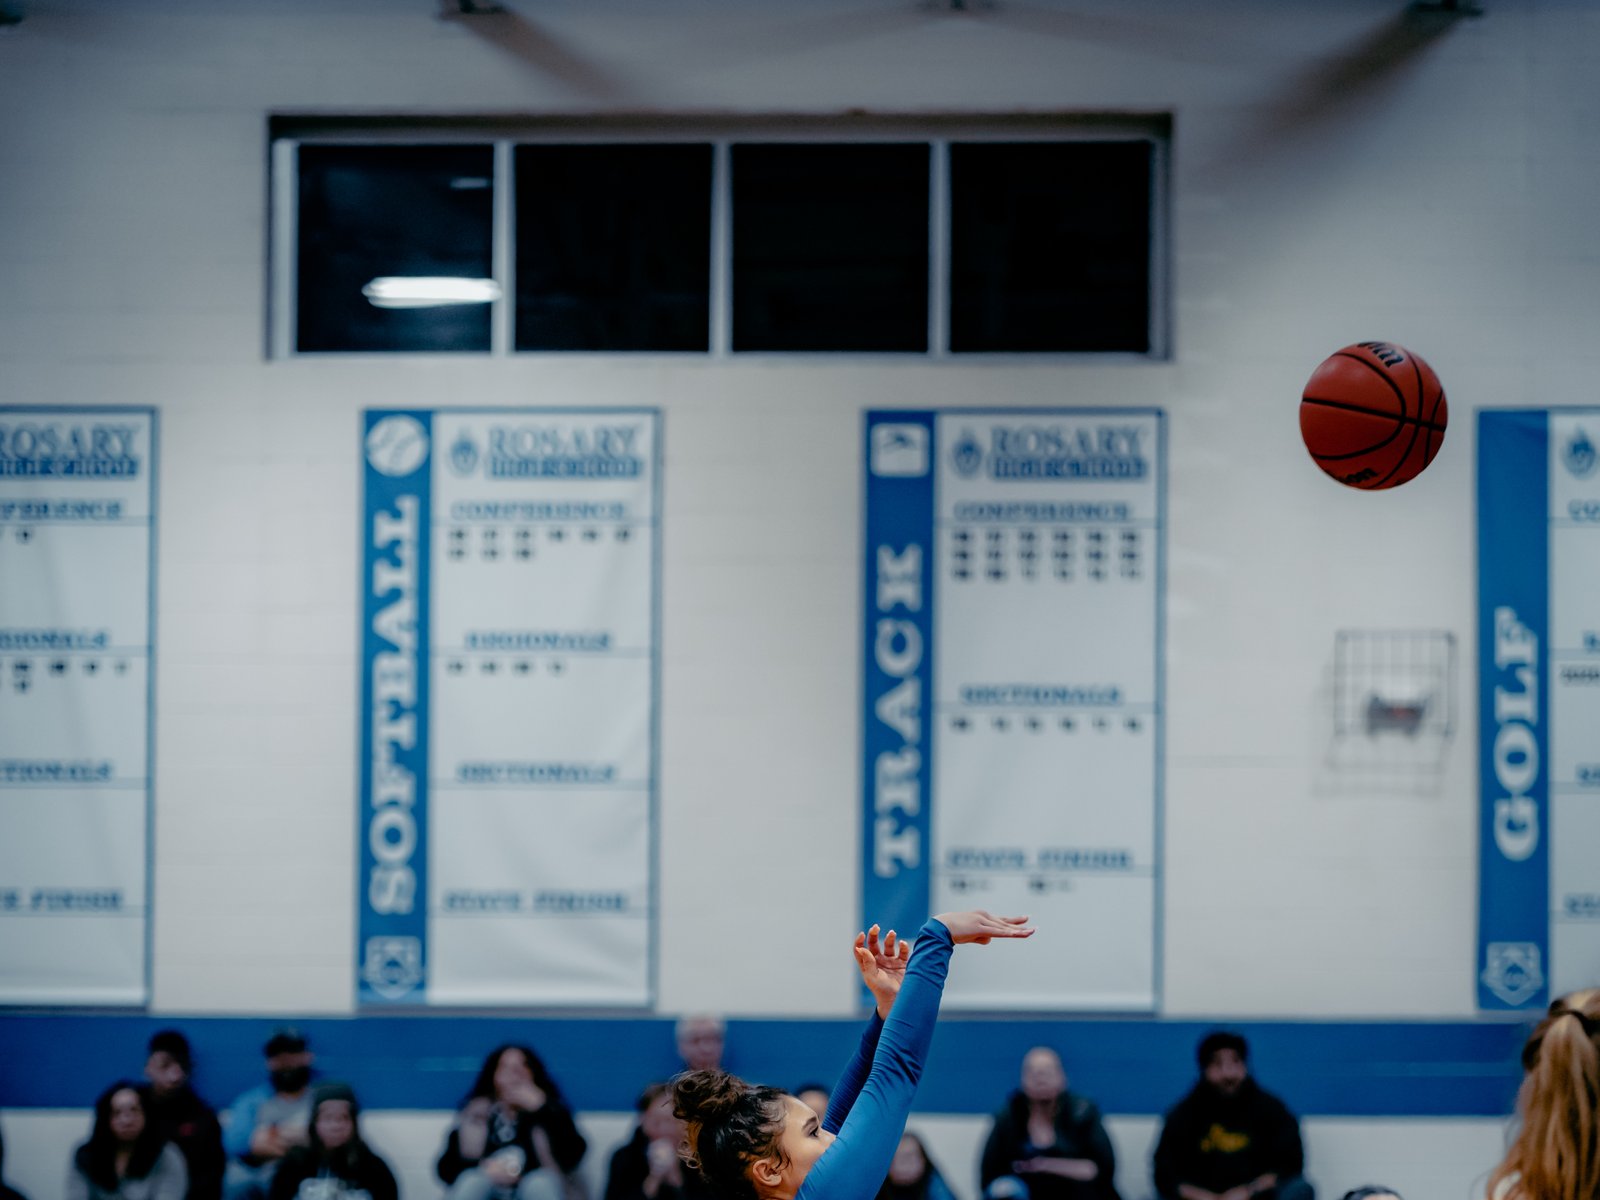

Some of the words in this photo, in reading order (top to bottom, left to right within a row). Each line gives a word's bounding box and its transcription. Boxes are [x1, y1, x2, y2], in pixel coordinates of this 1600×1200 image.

[489, 425, 641, 457] ROSARY
[991, 425, 1145, 457] ROSARY
[368, 495, 421, 915] SOFTBALL
[873, 543, 923, 878] TRACK
[1493, 606, 1539, 862] GOLF
